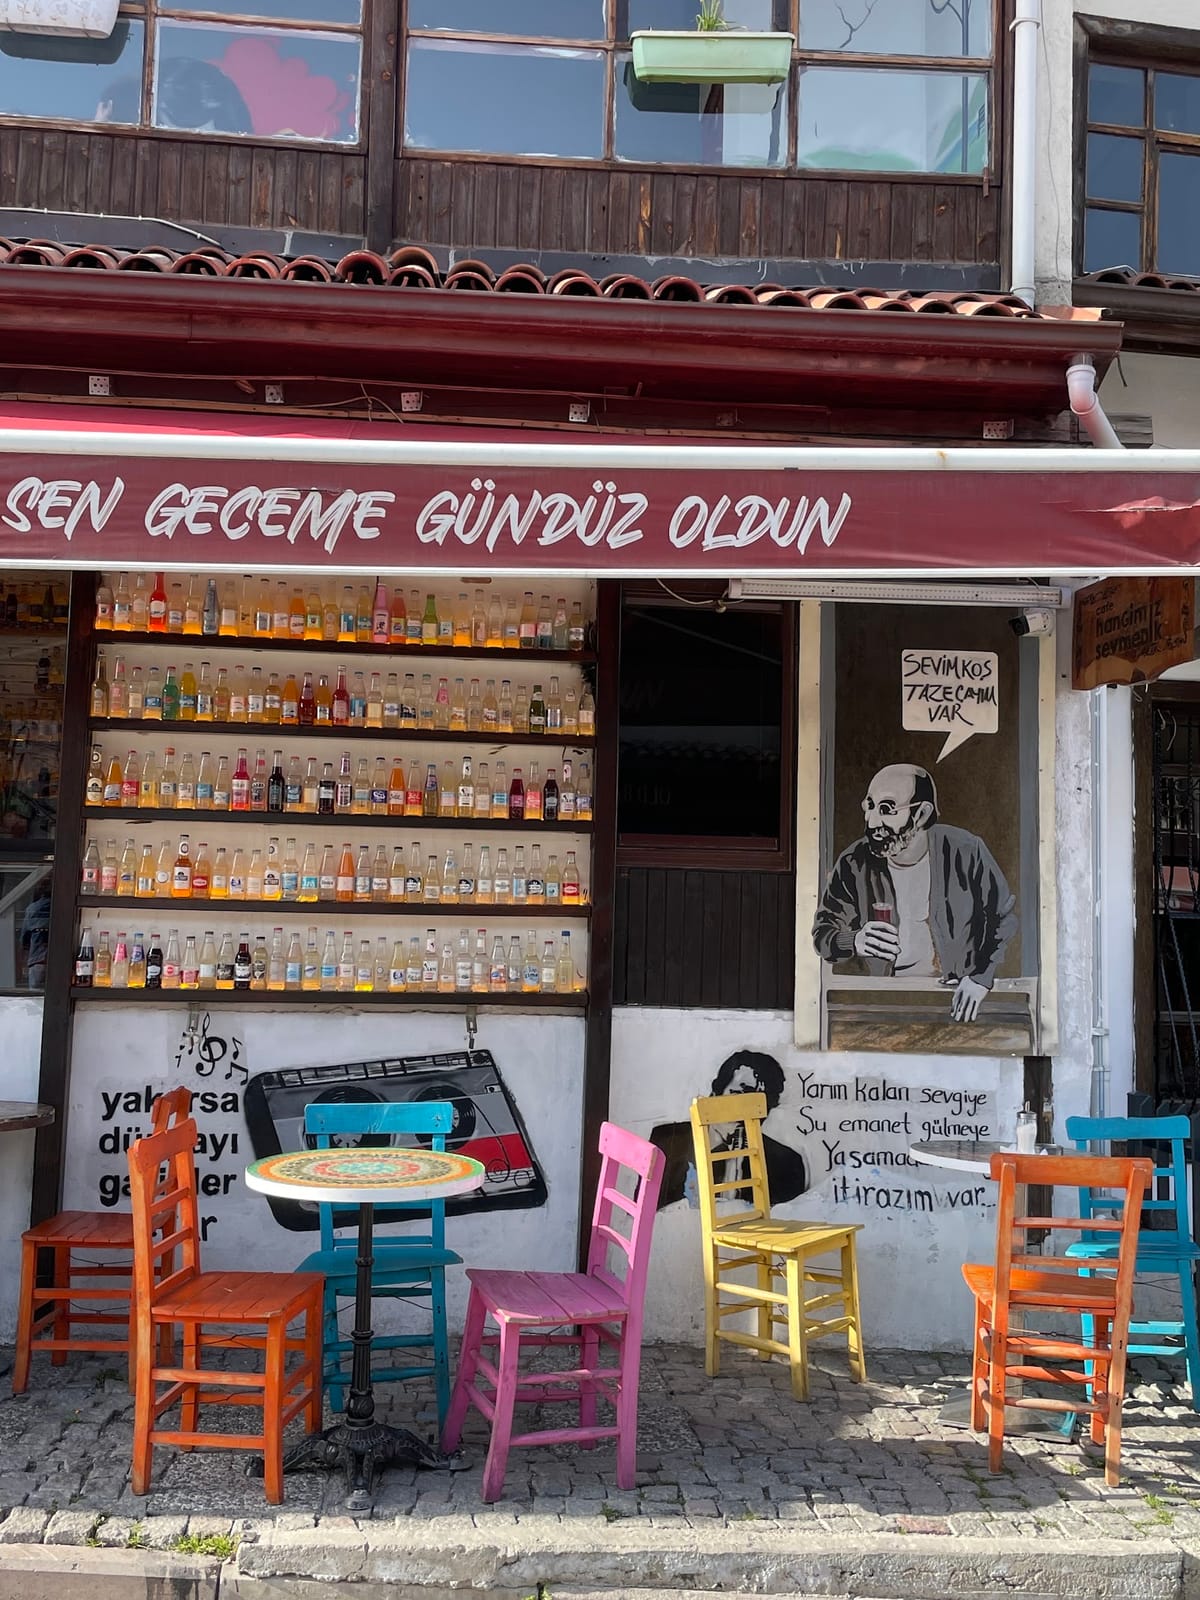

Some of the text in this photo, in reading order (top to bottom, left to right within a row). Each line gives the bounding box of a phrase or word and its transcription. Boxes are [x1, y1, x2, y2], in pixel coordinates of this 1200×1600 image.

[2, 476, 851, 555] SEN GECEME GÜNDÜZ OLDUN
[928, 703, 973, 726] VAR
[101, 1085, 239, 1121] yakrsa
[855, 1076, 909, 1102] kalan
[919, 1087, 988, 1116] sevgiye
[838, 1111, 912, 1135] emanet
[919, 1117, 990, 1143] gülmeye
[832, 1175, 934, 1212] itirazım
